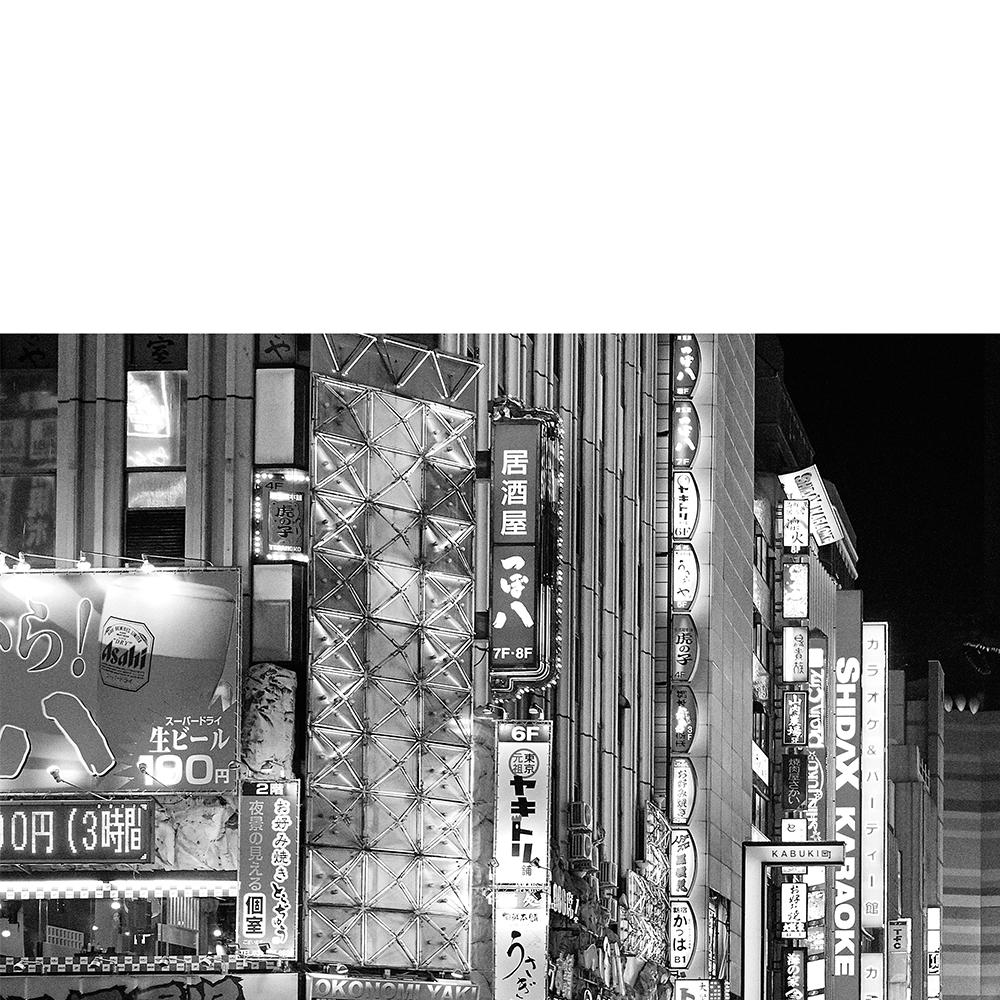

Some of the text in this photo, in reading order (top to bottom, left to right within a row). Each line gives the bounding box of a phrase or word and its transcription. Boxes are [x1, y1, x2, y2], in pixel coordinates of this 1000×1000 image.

[265, 482, 284, 490] 4F
[501, 450, 528, 536] 居酒屋
[0, 598, 93, 678] ら!
[102, 641, 147, 670] Asahi
[166, 716, 222, 726] スーパードライ
[511, 725, 540, 742] 6F
[836, 656, 860, 790] SHIDAX
[149, 726, 230, 753] 生ビール
[138, 754, 230, 785] 100円
[513, 754, 523, 774] 元祖
[524, 754, 534, 774] 東京
[255, 784, 284, 795] 2階
[509, 775, 537, 863] ヤキトリ
[249, 801, 264, 891] 夜景の見える
[273, 799, 291, 882] お好み焼き
[835, 806, 856, 976] KARAOKE
[246, 896, 263, 935] 個室
[315, 978, 477, 1000] OKONOMI YAKI
